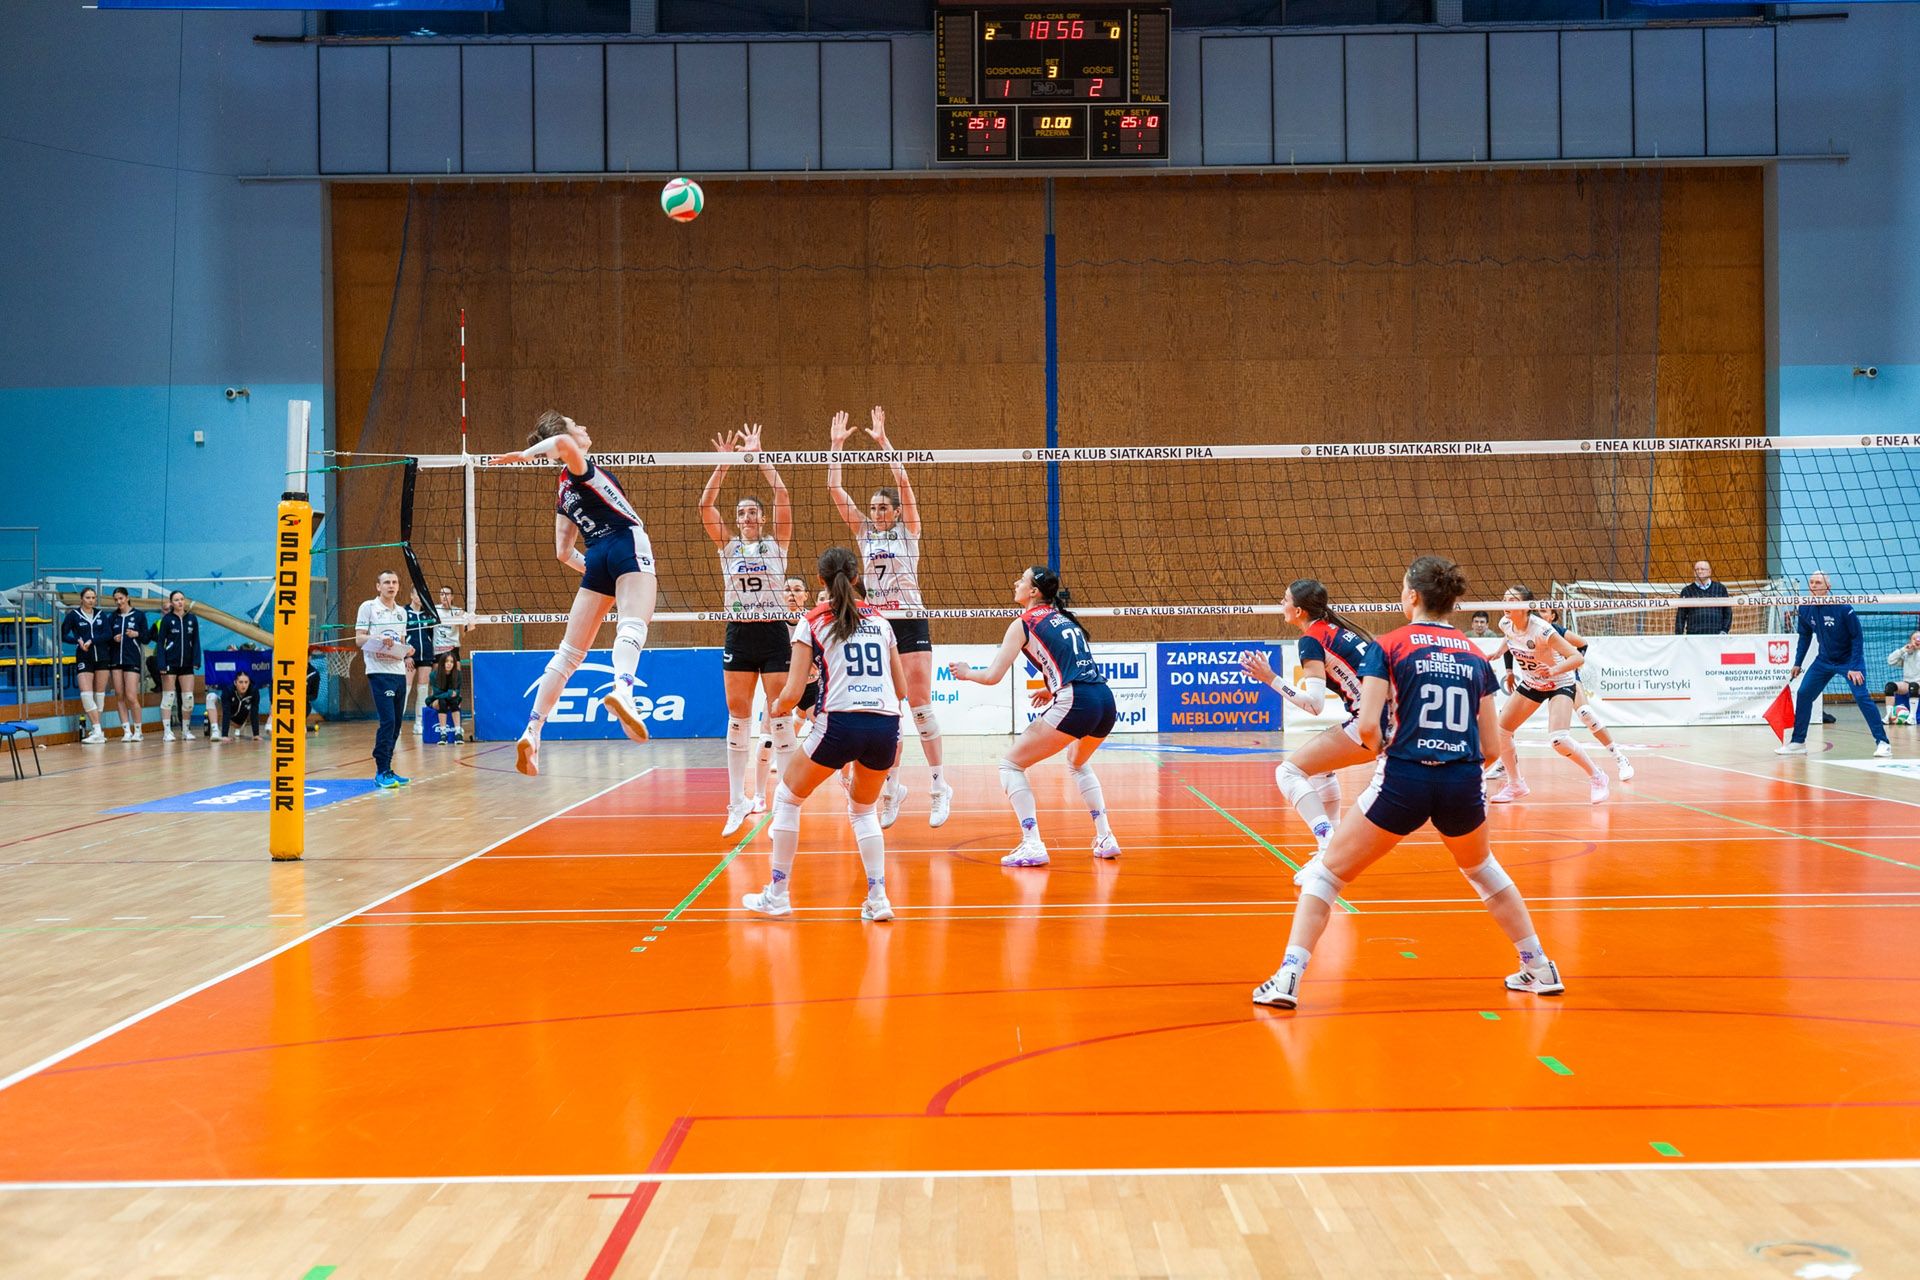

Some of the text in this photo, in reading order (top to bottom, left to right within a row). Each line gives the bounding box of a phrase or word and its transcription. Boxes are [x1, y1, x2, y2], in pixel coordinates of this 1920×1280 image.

[985, 28, 995, 40] 2
[1030, 21, 1084, 39] 18 56
[1110, 27, 1120, 39] 0
[986, 67, 1042, 75] GOSPODARZE
[1048, 66, 1058, 78] 3
[1004, 80, 1010, 97] 1
[1090, 79, 1104, 97] 2
[1041, 117, 1072, 129] 0.00
[1595, 438, 1773, 451] ENEA KLUB SIATKARSKI PIŁA
[1876, 436, 1909, 446] ENEA
[1037, 447, 1213, 460] ENEA KLUB SIATKARSKI PIŁA
[1316, 443, 1492, 456] ENEA KLUB SIATKARSKI PIŁA
[628, 454, 656, 465] PIŁA
[759, 451, 934, 463] ENEA KLUB SIATKARSKI PIŁA
[573, 508, 596, 533] 5
[738, 563, 767, 573] Enea
[875, 565, 886, 580] 7
[279, 532, 299, 625] SPORT
[740, 577, 762, 593] 19
[1594, 600, 1646, 608] SIATKARSKI
[1650, 599, 1670, 607] PIŁA
[1748, 595, 1878, 606] ENEA KLUB SIATKARSKI PIŁA
[970, 609, 1023, 618] SIATKARSKI
[1178, 606, 1226, 615] SIATKARSKI
[1230, 605, 1253, 614] PIŁA
[501, 614, 526, 623] ENEA
[528, 614, 552, 622] KLUB
[1061, 628, 1090, 655] 77
[1410, 634, 1471, 651] GREJMAN
[844, 643, 883, 677] 99
[1430, 652, 1456, 663] ENEA
[1415, 660, 1473, 680] ENERGETYK
[1516, 659, 1537, 671] 22
[1171, 672, 1193, 685] DO
[1333, 666, 1348, 682] ENEA
[1601, 667, 1669, 677] Ministerstwo
[1600, 681, 1635, 691] Sportu
[1644, 679, 1691, 691] Turystyki
[1120, 690, 1147, 700] wygody
[1181, 689, 1259, 705] SALONÓW
[1419, 683, 1469, 732] 20
[1172, 711, 1269, 725] MEBLOWYCH
[276, 660, 295, 811] TRANSFER
